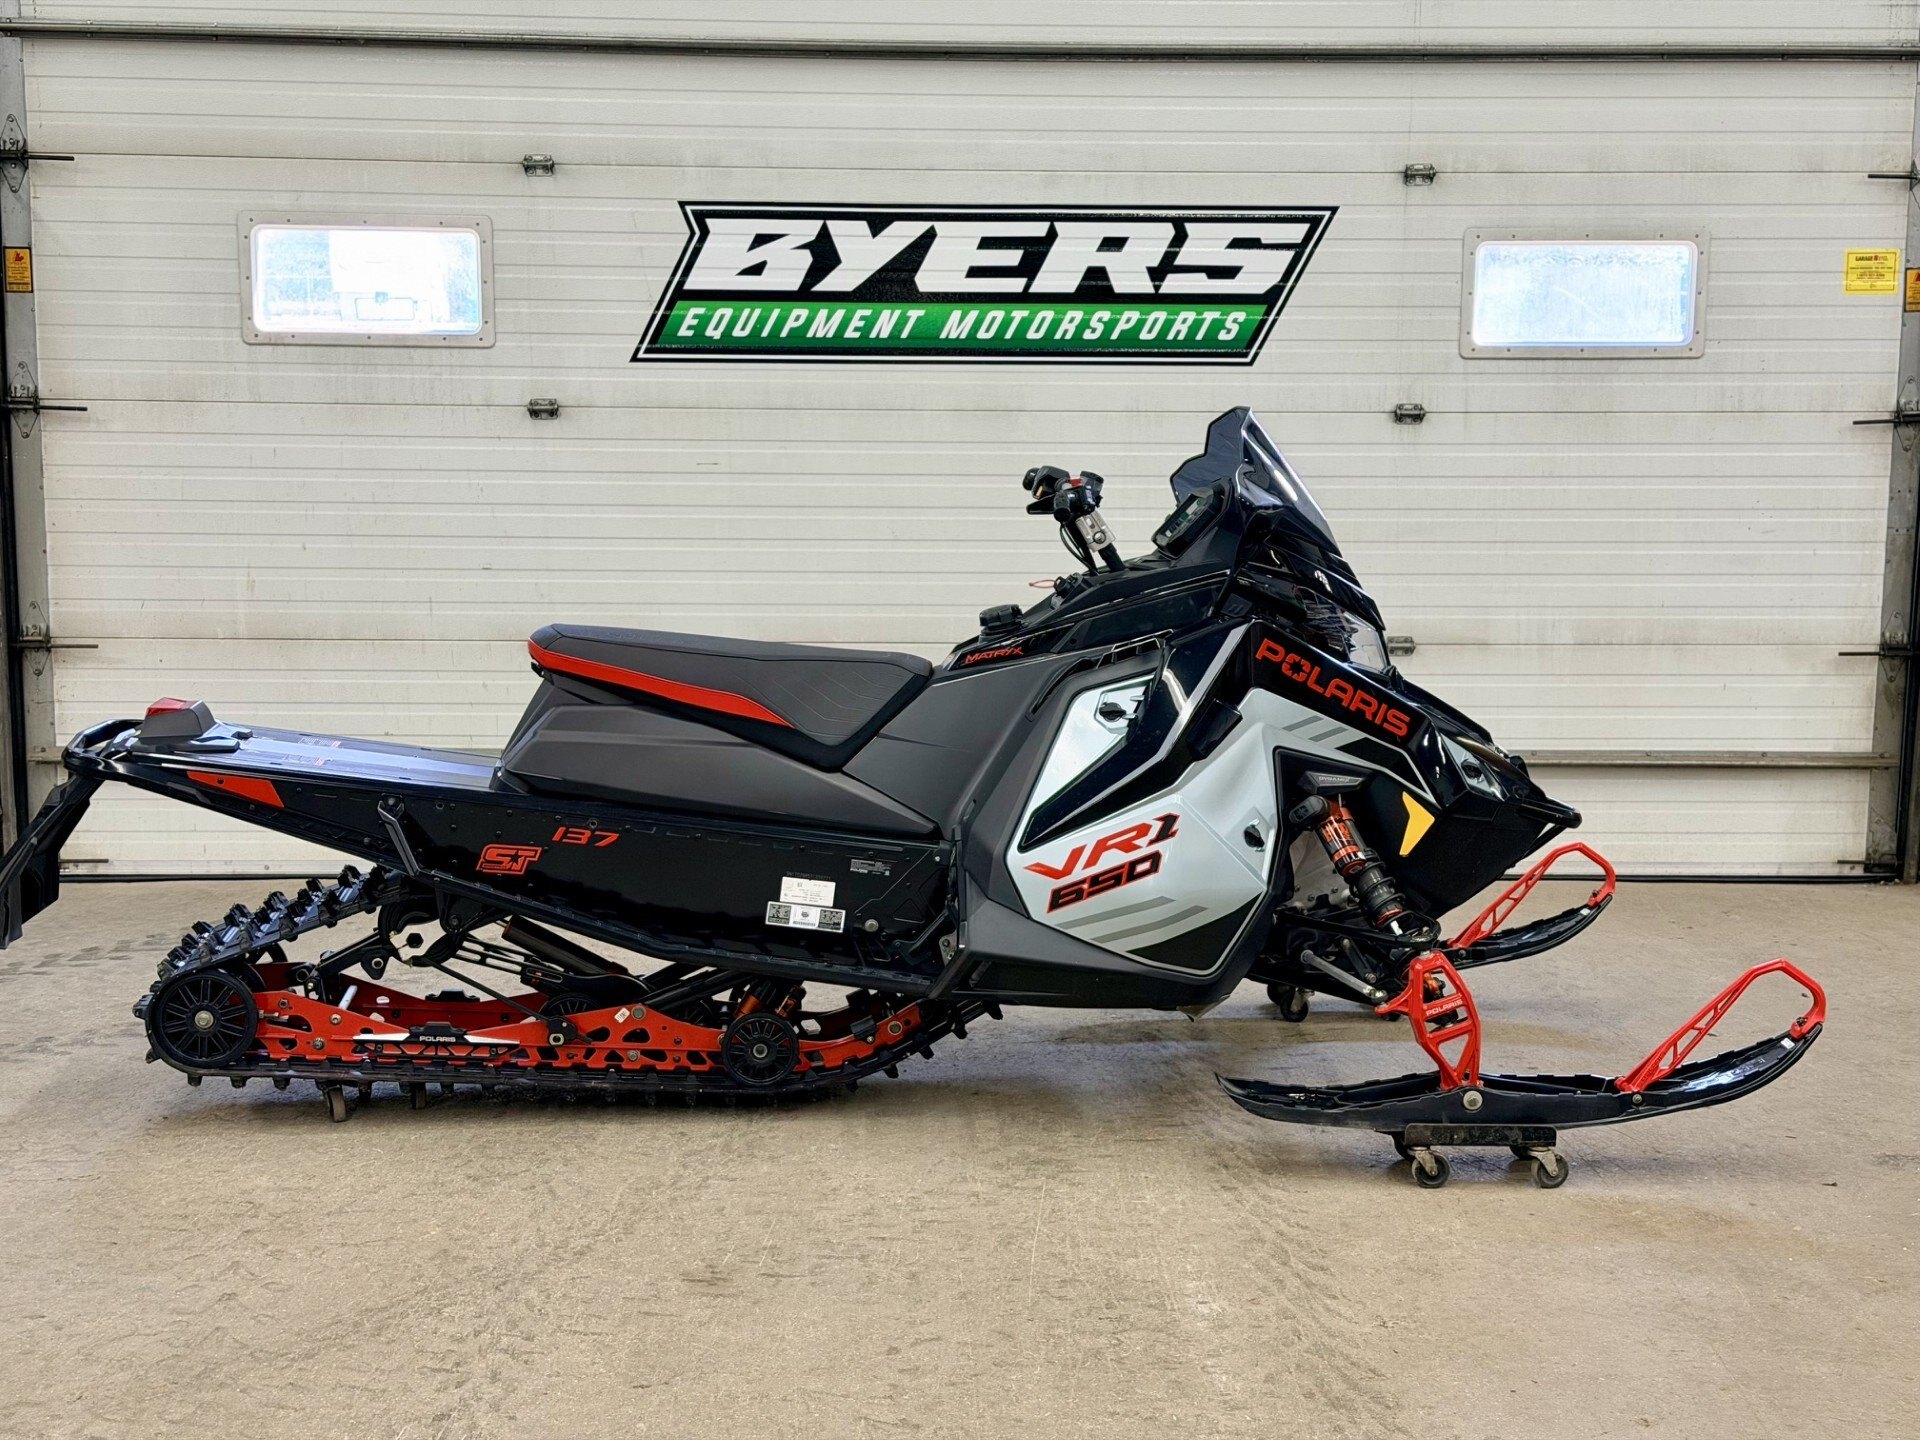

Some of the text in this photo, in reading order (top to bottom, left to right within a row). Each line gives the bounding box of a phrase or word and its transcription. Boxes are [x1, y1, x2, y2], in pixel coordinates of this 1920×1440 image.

[682, 218, 1311, 295] BYERS
[676, 307, 1247, 342] EQUIPMENT MOTORSPORTS
[964, 646, 1024, 665] MATRYX
[1255, 638, 1411, 737] POLARIS
[552, 826, 620, 848] 137
[1023, 812, 1181, 881] VR1
[480, 845, 539, 873] ST
[1046, 849, 1163, 914] 650
[1426, 998, 1463, 1016] POLARIS
[419, 1035, 456, 1043] POLARIS
